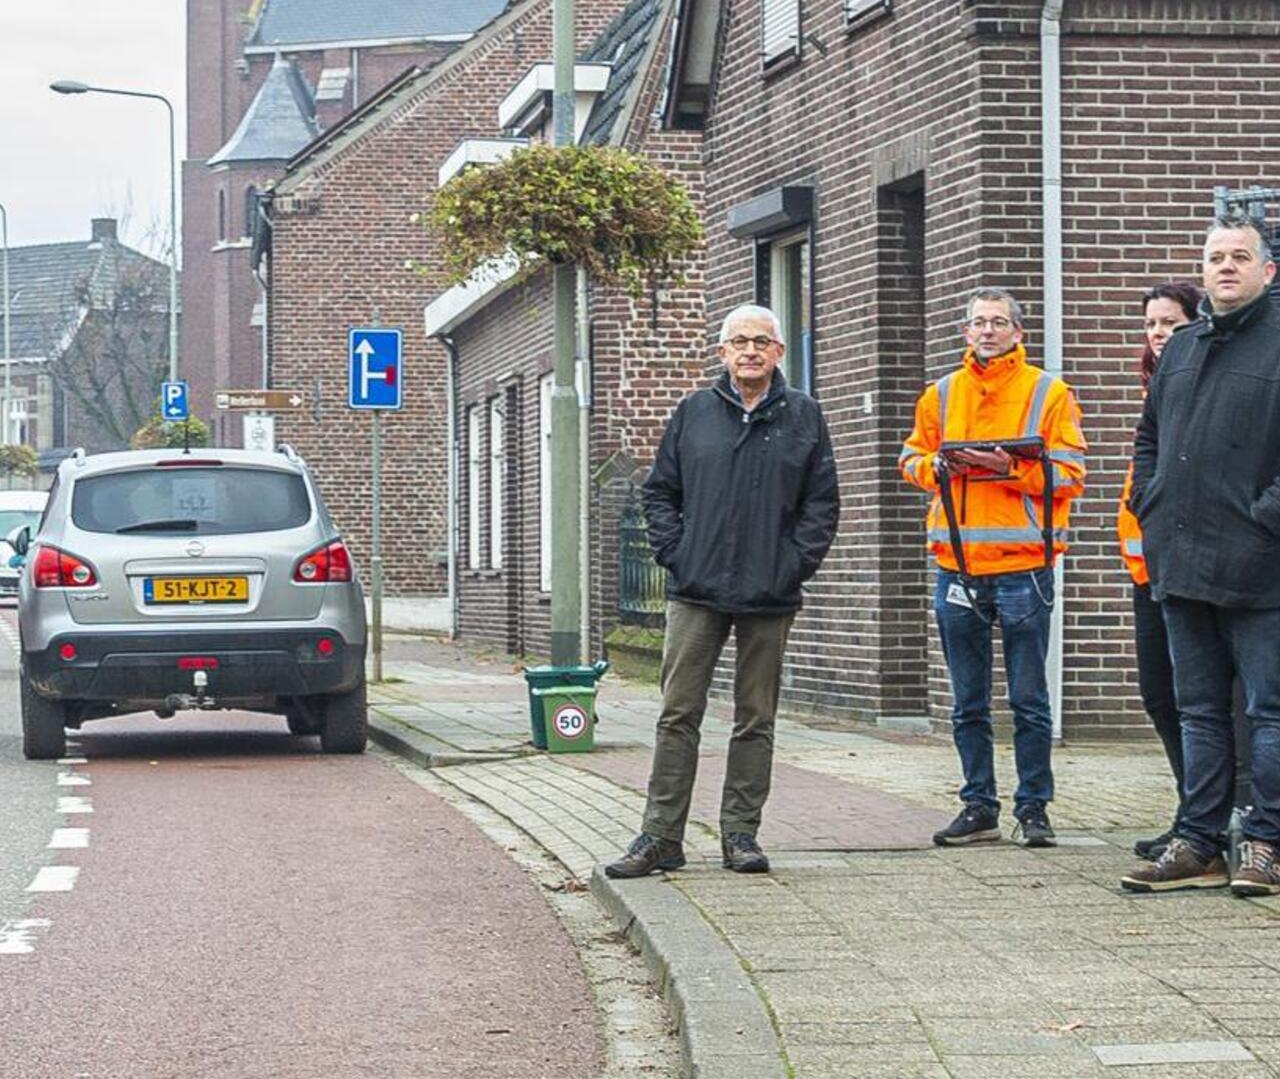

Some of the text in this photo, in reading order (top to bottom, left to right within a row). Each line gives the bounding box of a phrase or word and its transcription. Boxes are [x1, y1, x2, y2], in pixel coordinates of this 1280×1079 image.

[167, 385, 182, 405] P
[163, 580, 237, 598] 51-KJT-2
[559, 715, 581, 730] 50
